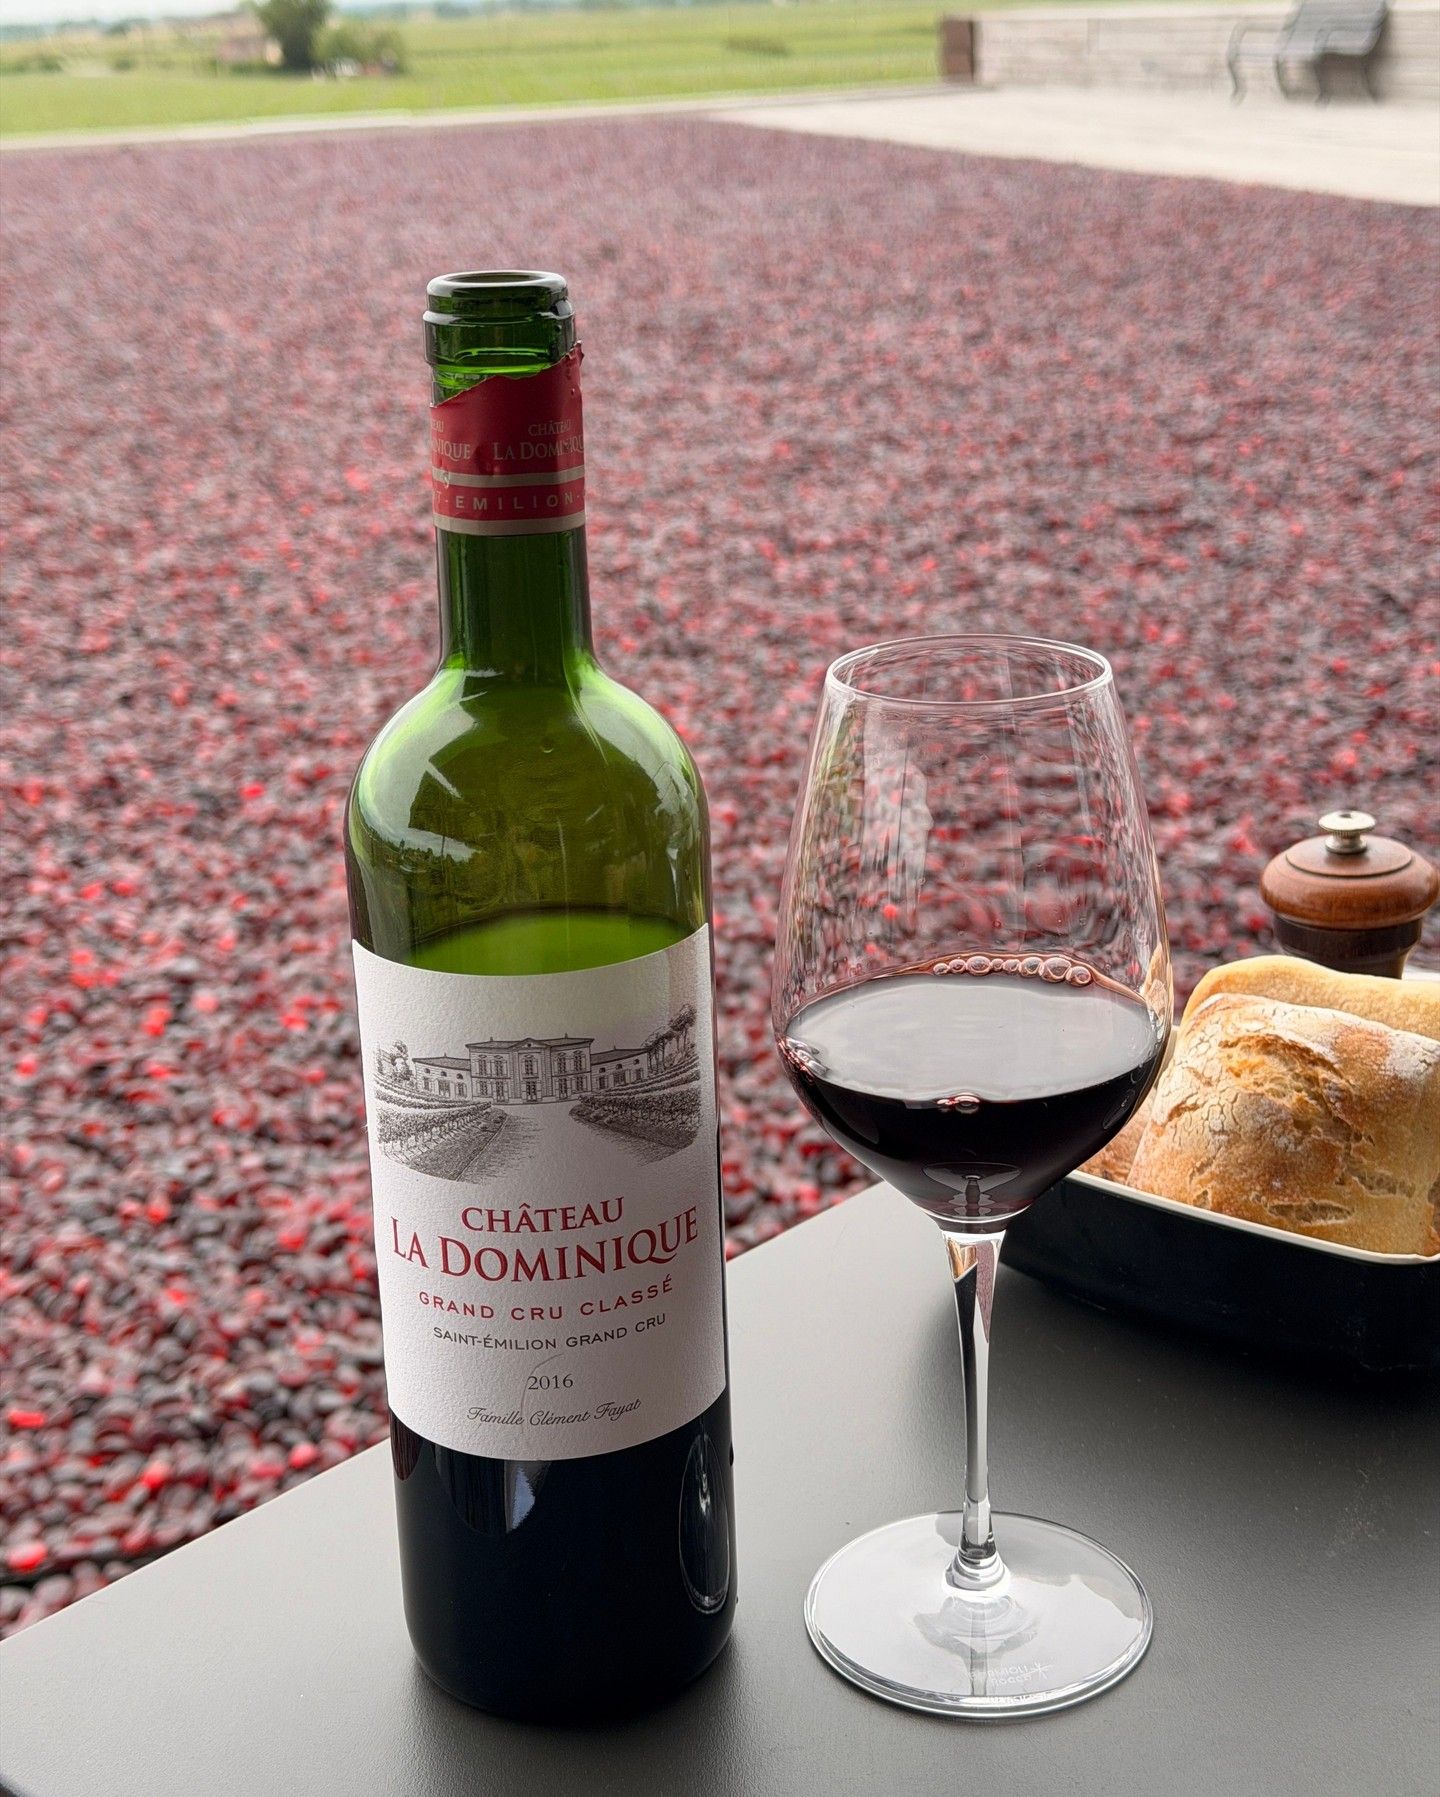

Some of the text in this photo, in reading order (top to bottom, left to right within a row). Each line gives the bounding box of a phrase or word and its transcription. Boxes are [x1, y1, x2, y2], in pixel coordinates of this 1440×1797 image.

[492, 441, 516, 461] LA
[461, 1196, 625, 1233] CHÂTEAU
[390, 1205, 698, 1282] LA DOMINIQUE
[419, 1273, 673, 1321] GRAND CRU CLASSÉ
[433, 1313, 666, 1351] SAINT-ÉMILION GRAND CRU
[527, 1373, 574, 1390] 2016
[467, 1399, 642, 1426] Famille Clément Fayat
